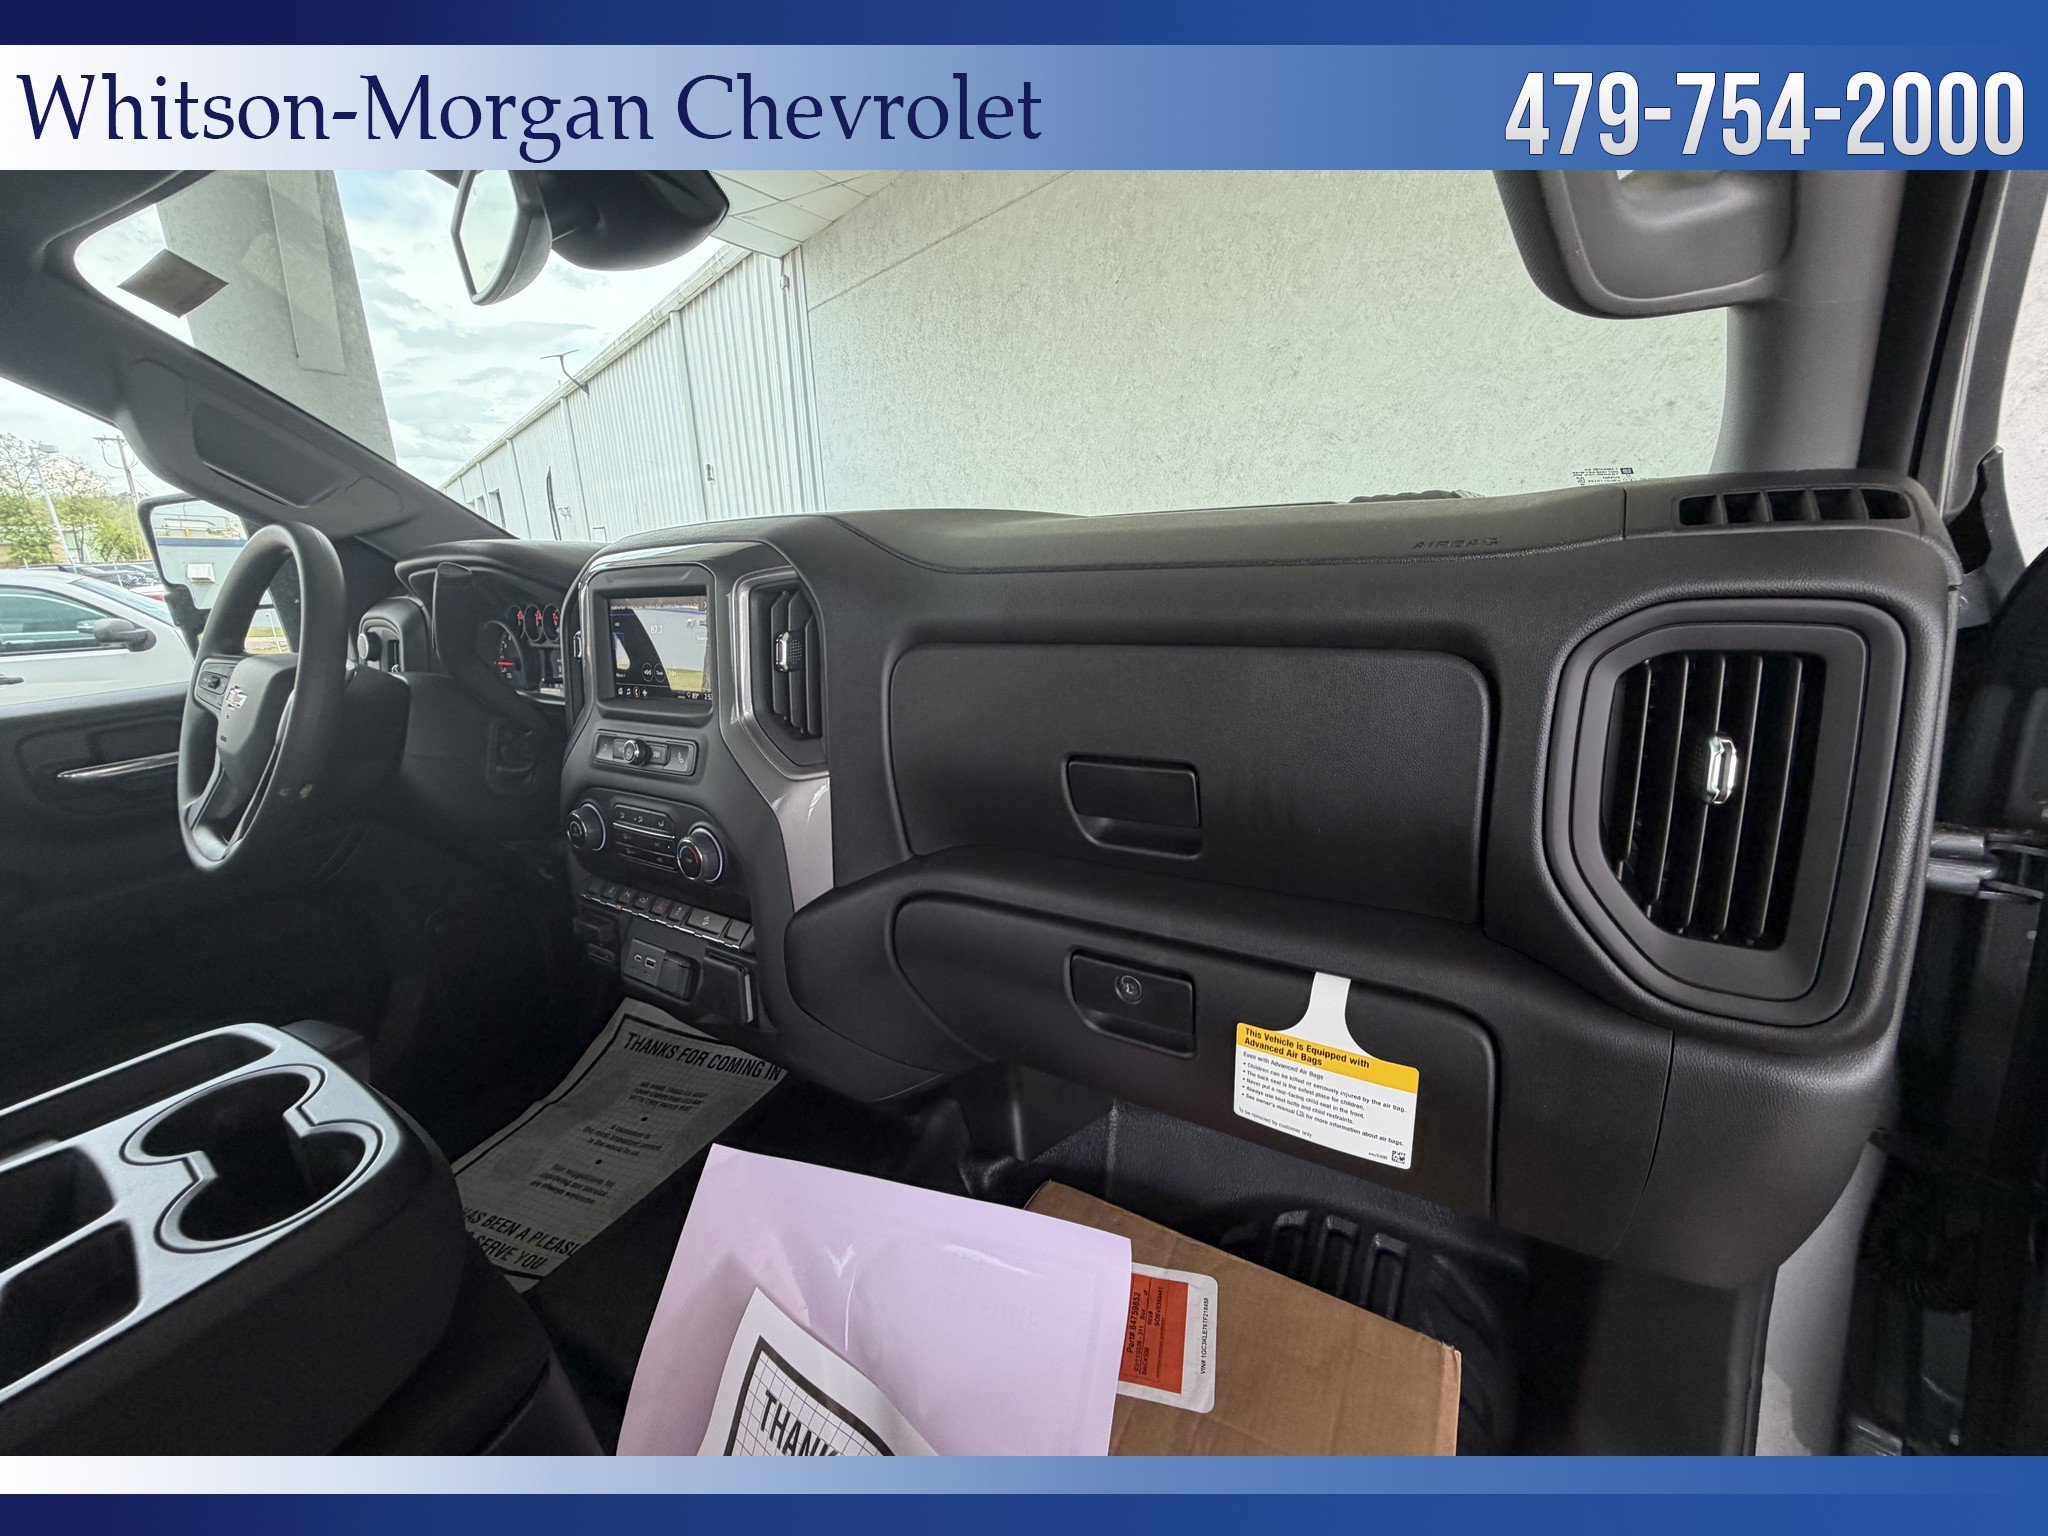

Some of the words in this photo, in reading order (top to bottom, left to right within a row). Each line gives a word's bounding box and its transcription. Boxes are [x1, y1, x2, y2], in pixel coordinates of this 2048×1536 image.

[1412, 537, 1498, 549] AIRBAG
[624, 1032, 680, 1059] THANKS
[677, 1047, 708, 1065] FOR
[707, 1054, 766, 1078] COMING
[764, 1064, 782, 1081] IN
[1245, 1037, 1284, 1055] Advanced
[1286, 1050, 1298, 1059] Air
[1301, 1053, 1322, 1066] Bags
[1246, 1027, 1262, 1039] This
[1264, 1033, 1294, 1048] Vehicle
[1296, 1042, 1304, 1051] is
[1306, 1045, 1347, 1062] Equipped
[1349, 1057, 1370, 1068] with
[1243, 1051, 1256, 1060] Even
[1258, 1056, 1270, 1064] with
[1271, 1060, 1298, 1072] Advanced
[1309, 1071, 1323, 1080] Bags
[1246, 1078, 1261, 1087] Never
[1276, 1088, 1305, 1102] rear-facing
[1305, 1097, 1319, 1106] child
[1247, 1062, 1269, 1073] Children
[1289, 1076, 1305, 1084] killed
[1313, 1083, 1339, 1095] seriously
[1340, 1090, 1361, 1100] injured
[1257, 1073, 1269, 1081] back
[1298, 1087, 1315, 1095] safest
[1315, 1092, 1330, 1100] place
[1246, 1086, 1263, 1096] Always
[1287, 1100, 1300, 1108] belts
[1312, 1107, 1325, 1116] child
[1246, 1093, 1255, 1101] See
[1276, 1105, 1295, 1114] manual
[1314, 1117, 1328, 1125] more
[1329, 1121, 1361, 1134] information
[1362, 1131, 1378, 1140] about
[481, 1215, 521, 1236] BEEN
[515, 1227, 531, 1241] A
[514, 1251, 548, 1270] YOU
[761, 1390, 839, 1457] THAN
